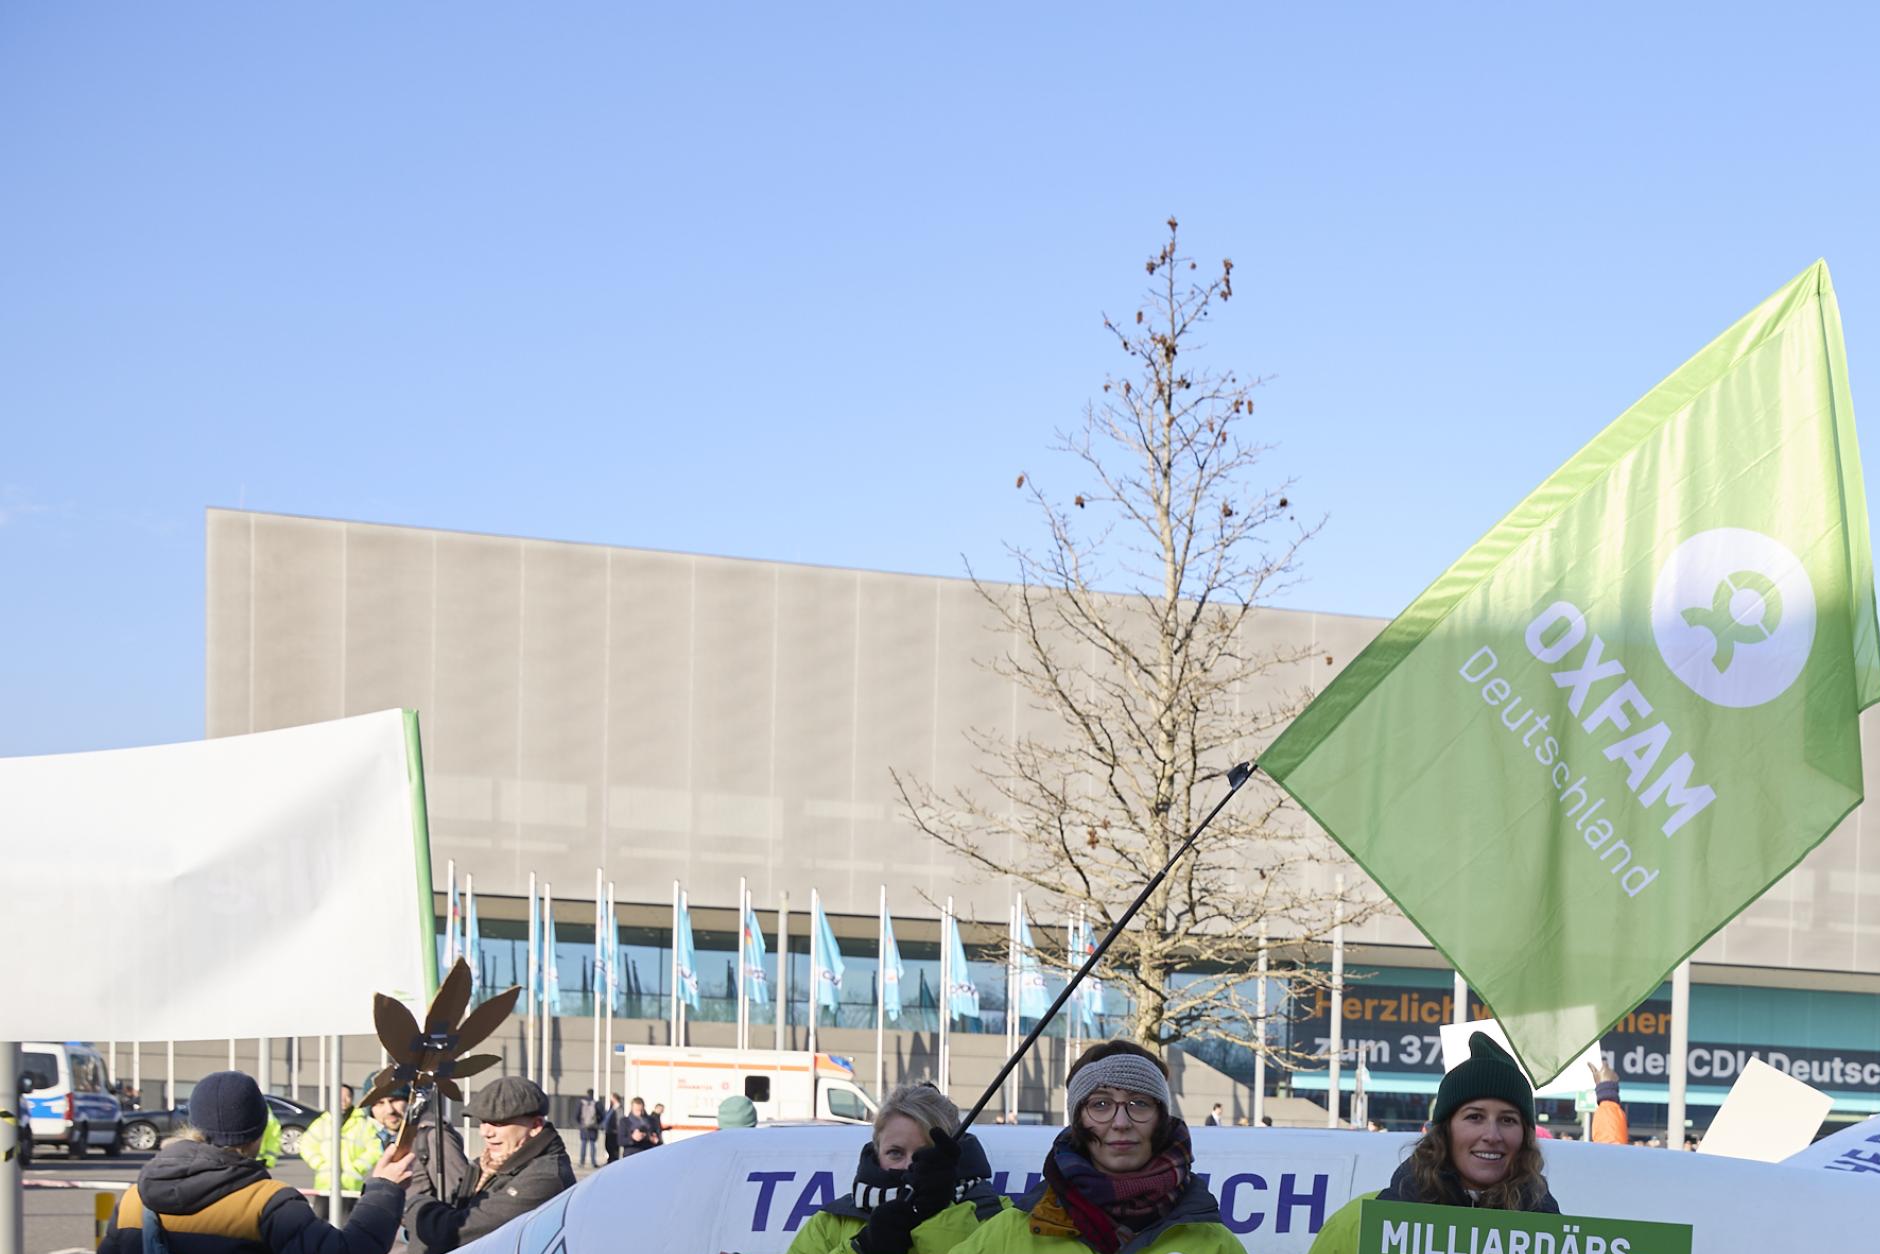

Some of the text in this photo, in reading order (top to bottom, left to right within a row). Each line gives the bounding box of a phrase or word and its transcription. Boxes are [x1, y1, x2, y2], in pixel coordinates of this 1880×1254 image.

[1457, 644, 1660, 898] Deutschland
[1524, 600, 1717, 839] OXFAM
[747, 1171, 1329, 1234] TA CH
